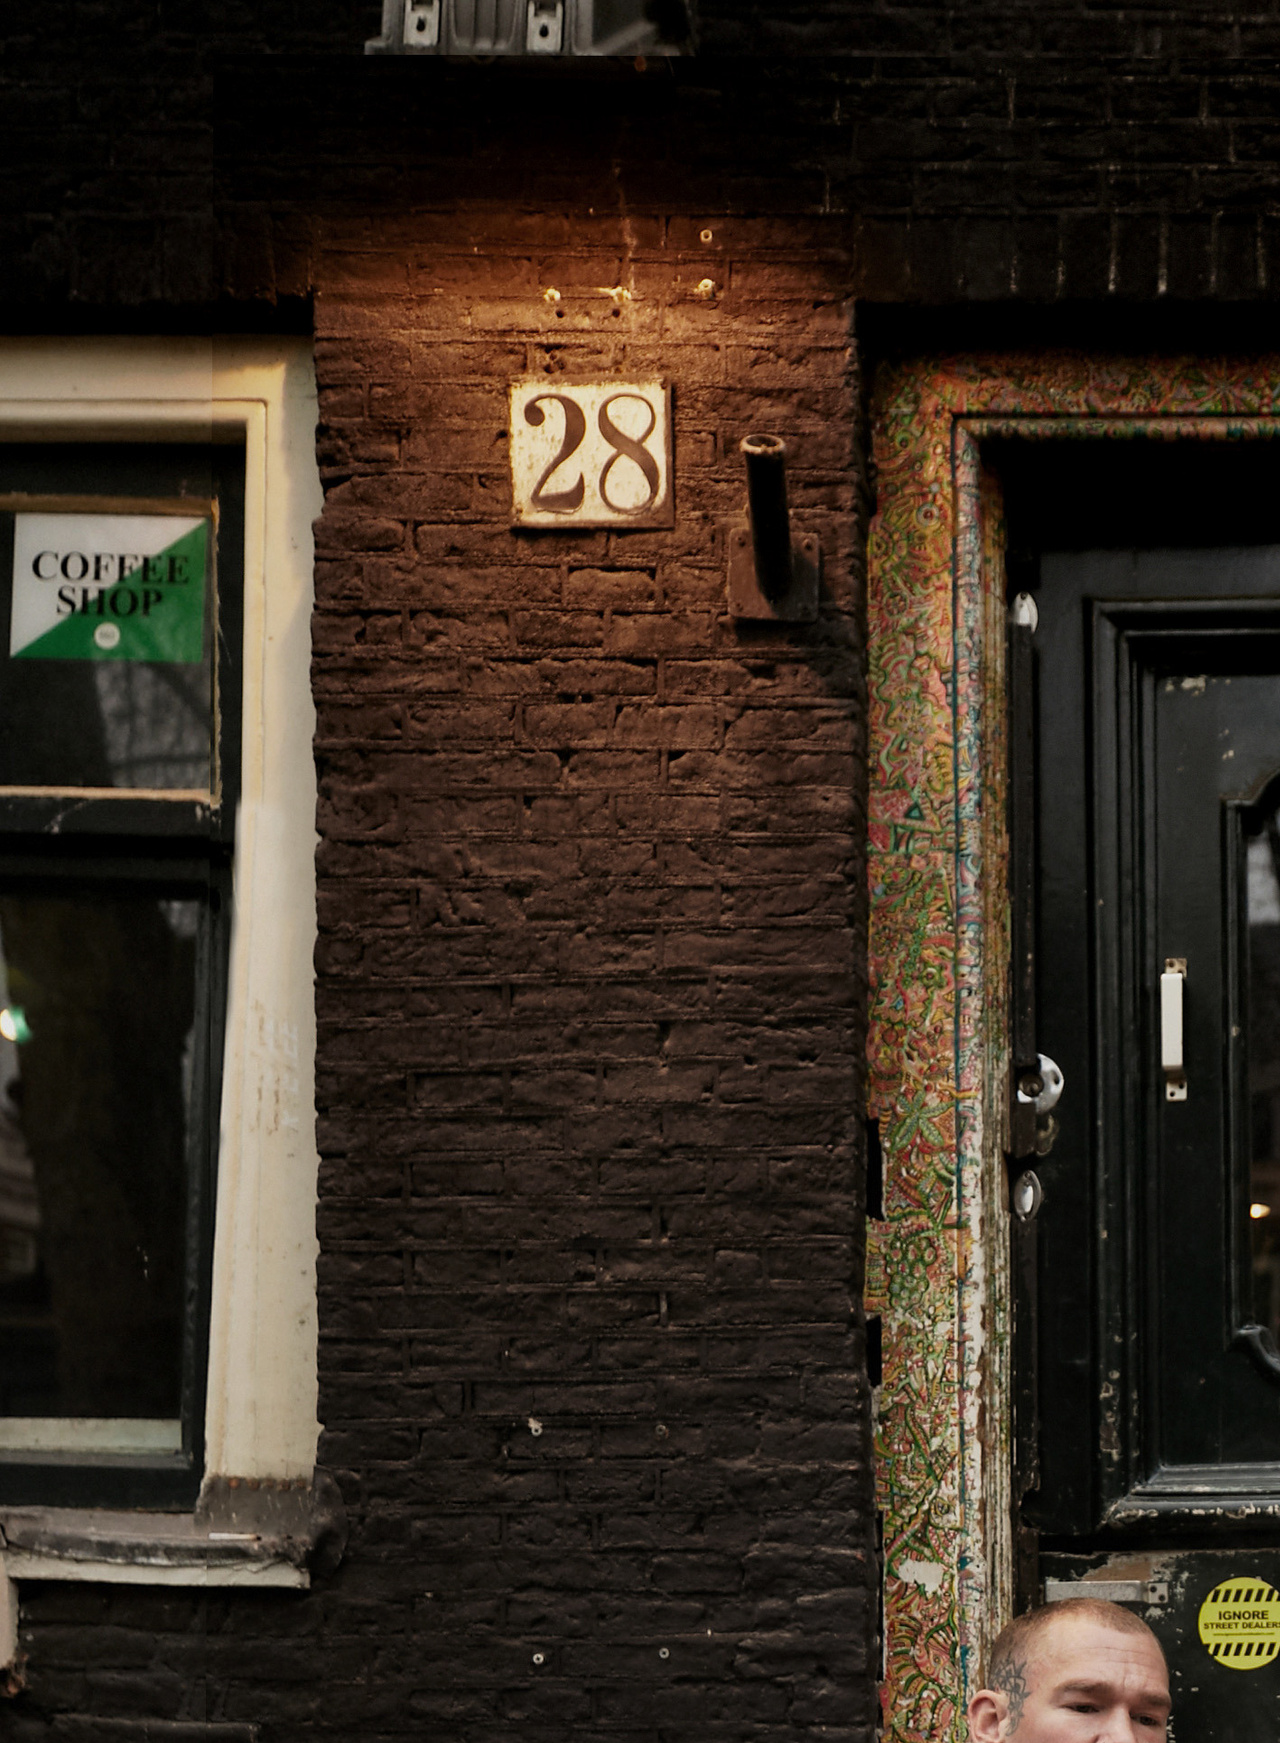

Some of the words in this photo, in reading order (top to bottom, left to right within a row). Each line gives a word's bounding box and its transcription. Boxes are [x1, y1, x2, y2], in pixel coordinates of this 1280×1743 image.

[523, 392, 660, 515] 28
[32, 551, 189, 584] COFFEE
[56, 585, 163, 618] SHOP
[1203, 1621, 1240, 1630] STREET
[1218, 1610, 1269, 1621] IGNORE
